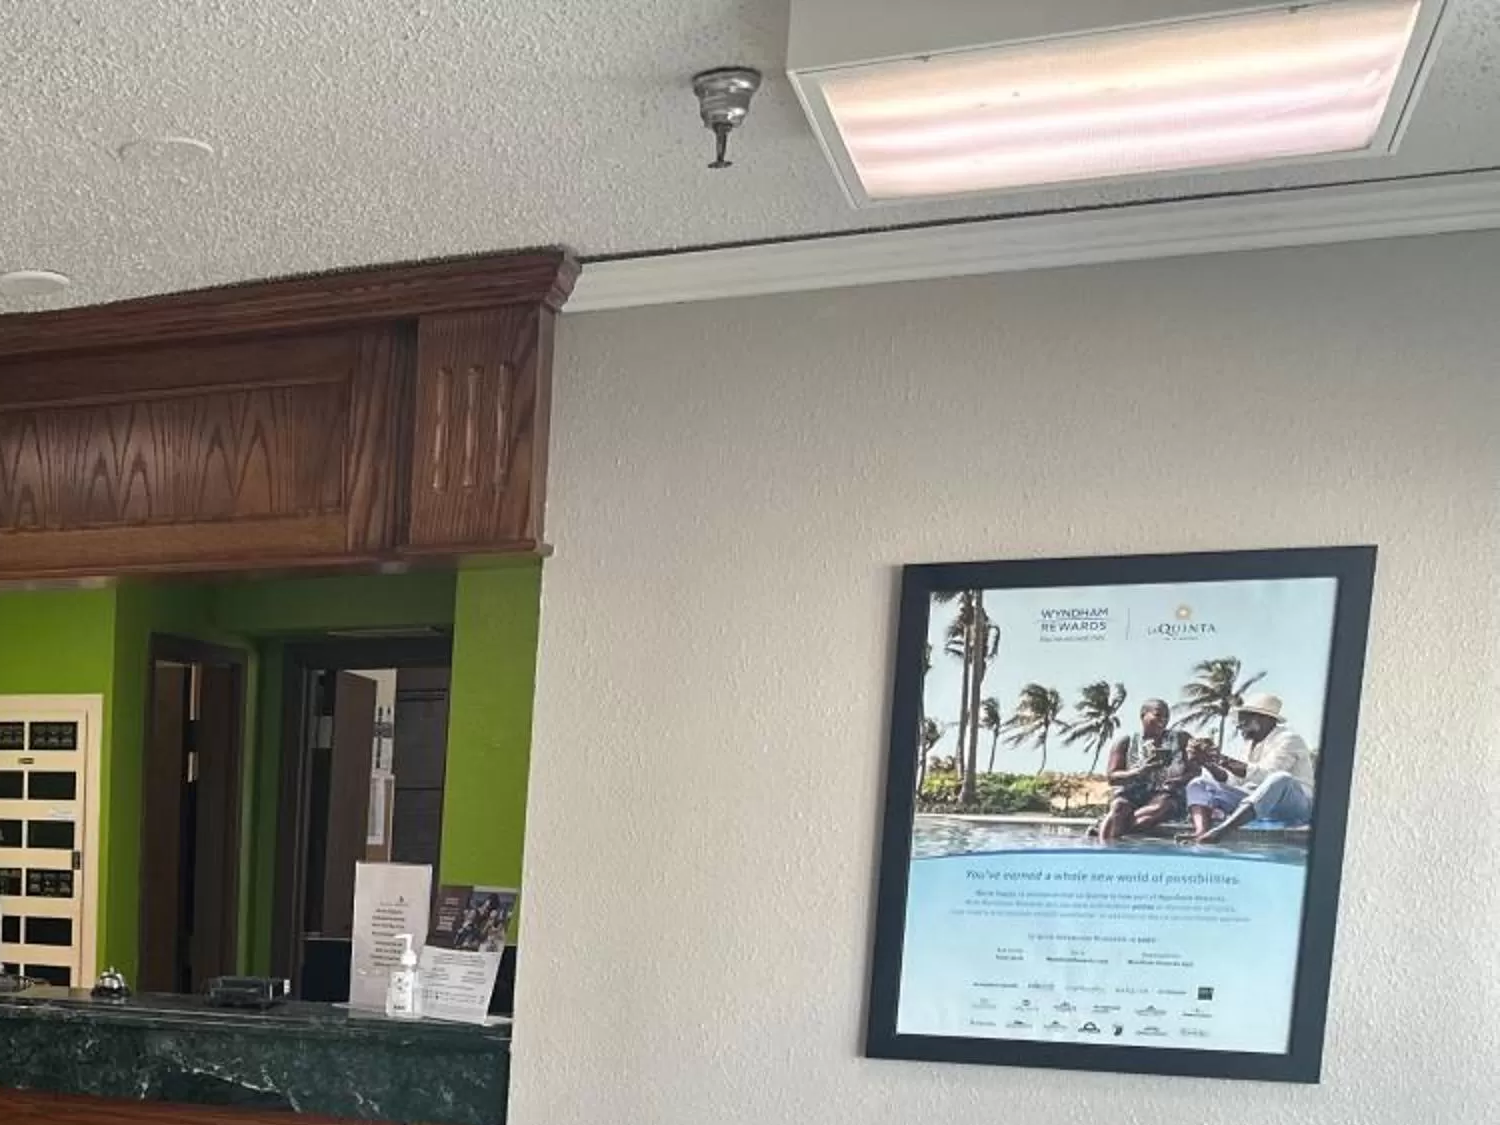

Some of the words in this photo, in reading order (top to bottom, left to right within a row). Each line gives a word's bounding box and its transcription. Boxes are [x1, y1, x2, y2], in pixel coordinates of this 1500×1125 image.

[1040, 607, 1109, 619] WYNDHAM
[1040, 620, 1107, 633] REWARDS
[1158, 623, 1217, 637] QUINTA
[1116, 871, 1149, 883] world
[1151, 872, 1164, 883] of
